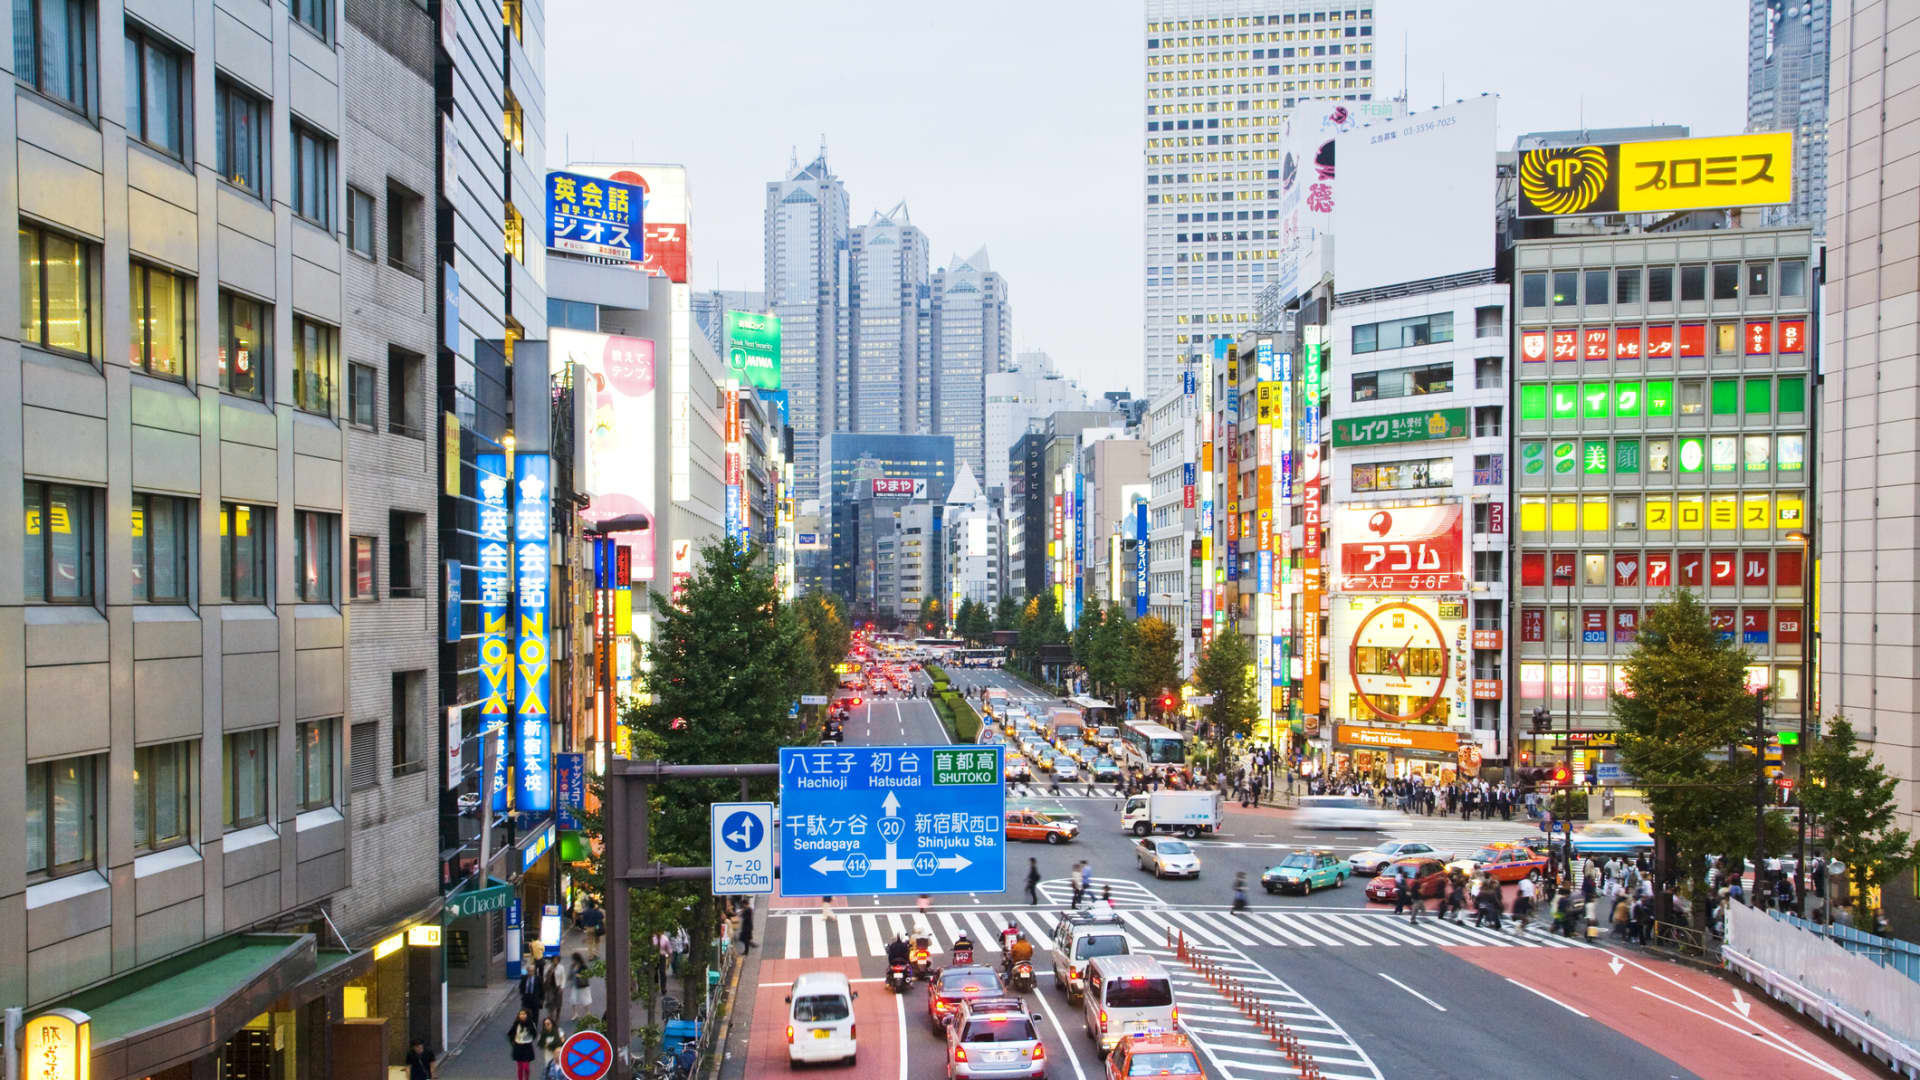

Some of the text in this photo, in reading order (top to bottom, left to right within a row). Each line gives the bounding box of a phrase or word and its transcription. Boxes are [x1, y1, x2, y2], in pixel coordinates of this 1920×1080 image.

[1404, 116, 1456, 136] 03-3556-7025
[1635, 153, 1775, 192] プロミス
[554, 177, 629, 213] 英会話
[554, 216, 631, 248] ジオス
[1556, 333, 1606, 343] ミスパリ
[1752, 325, 1764, 353] やせる
[1786, 328, 1797, 348] 8F
[1554, 341, 1691, 357] ダイエットセンター
[747, 355, 774, 368] MIWA
[1556, 392, 1637, 411] レイク
[1352, 420, 1389, 441] レイク
[1392, 417, 1422, 429] 無人受付
[1392, 429, 1422, 438] コーナー
[1584, 445, 1638, 470] 美顔
[877, 481, 911, 491] やまや
[1305, 487, 1319, 523] アコム
[1492, 505, 1501, 532] アコム
[1650, 506, 1764, 523] プロミス
[1781, 509, 1797, 520] 5F
[519, 510, 546, 608] 英会話
[1363, 544, 1441, 571] アコム
[1555, 565, 1572, 576] 4F
[1650, 561, 1765, 578] アイフル
[1368, 576, 1394, 589] 入口
[1587, 613, 1634, 628] 三和
[518, 612, 547, 715] NOVA
[523, 720, 543, 792] 新宿本校
[788, 752, 920, 774] 八王子 初台
[936, 752, 994, 771] 首都高
[797, 775, 921, 790] Hachioji Hatsudai
[938, 772, 992, 784] SHUTOKO
[883, 821, 899, 836] 20
[915, 812, 999, 834] 新宿駅西口
[794, 838, 860, 851] Sendagaya
[918, 836, 997, 849] Shinjuku Sta.
[847, 858, 866, 871] 414
[916, 858, 934, 870] 414
[718, 874, 768, 886] この先50m
[463, 893, 506, 916] Chacott
